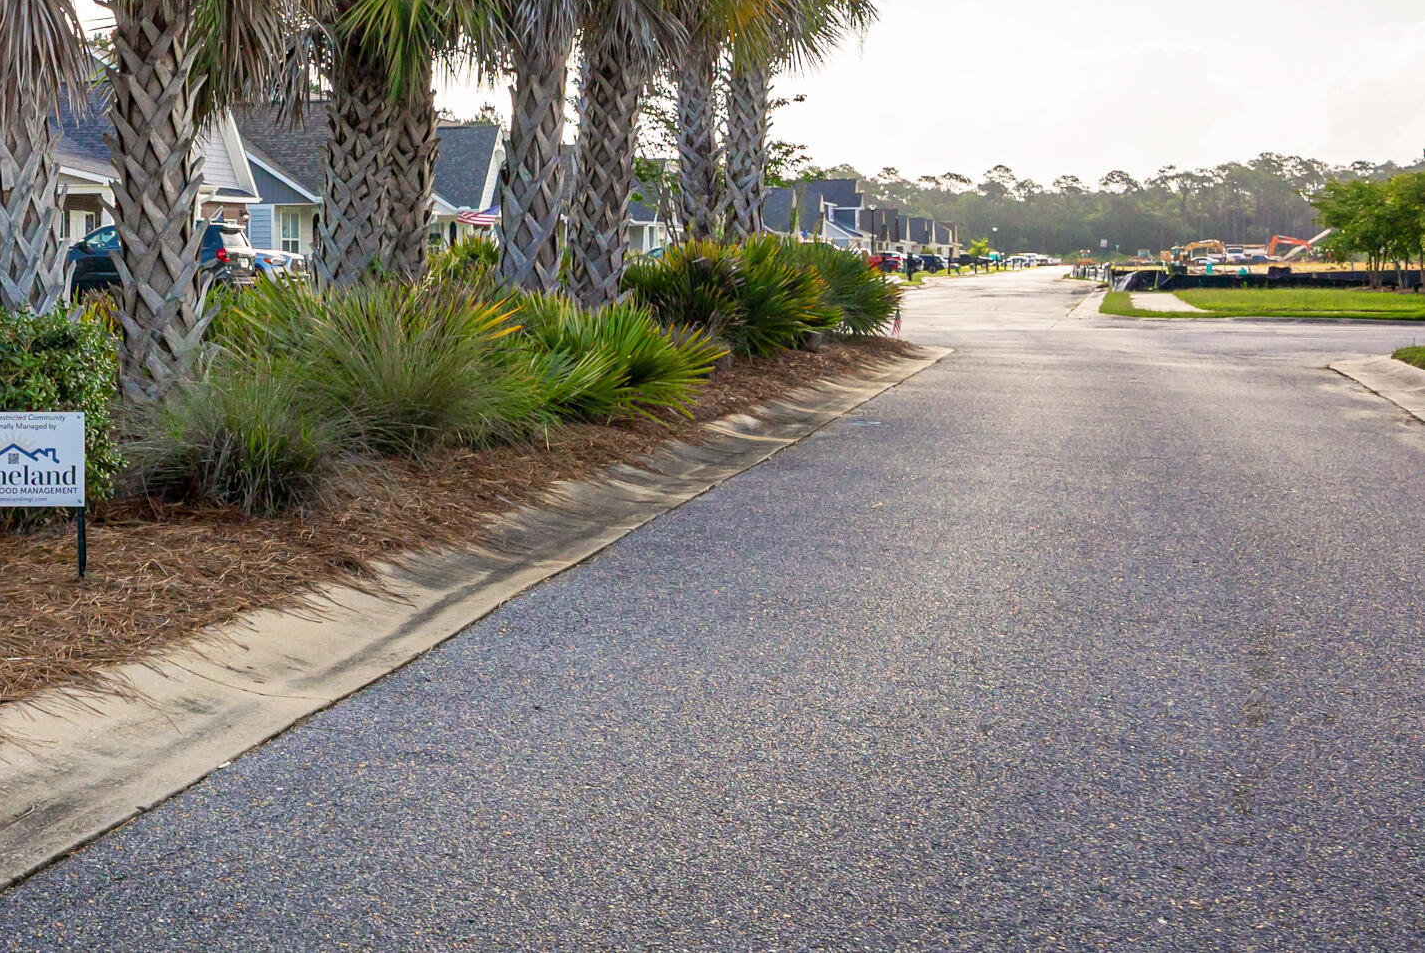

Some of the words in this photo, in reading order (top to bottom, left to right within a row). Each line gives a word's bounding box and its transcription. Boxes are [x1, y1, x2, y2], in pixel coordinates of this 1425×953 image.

[27, 413, 66, 422] Community
[15, 422, 47, 431] Managed
[48, 422, 57, 431] by
[20, 487, 78, 495] MANAGEMENT
